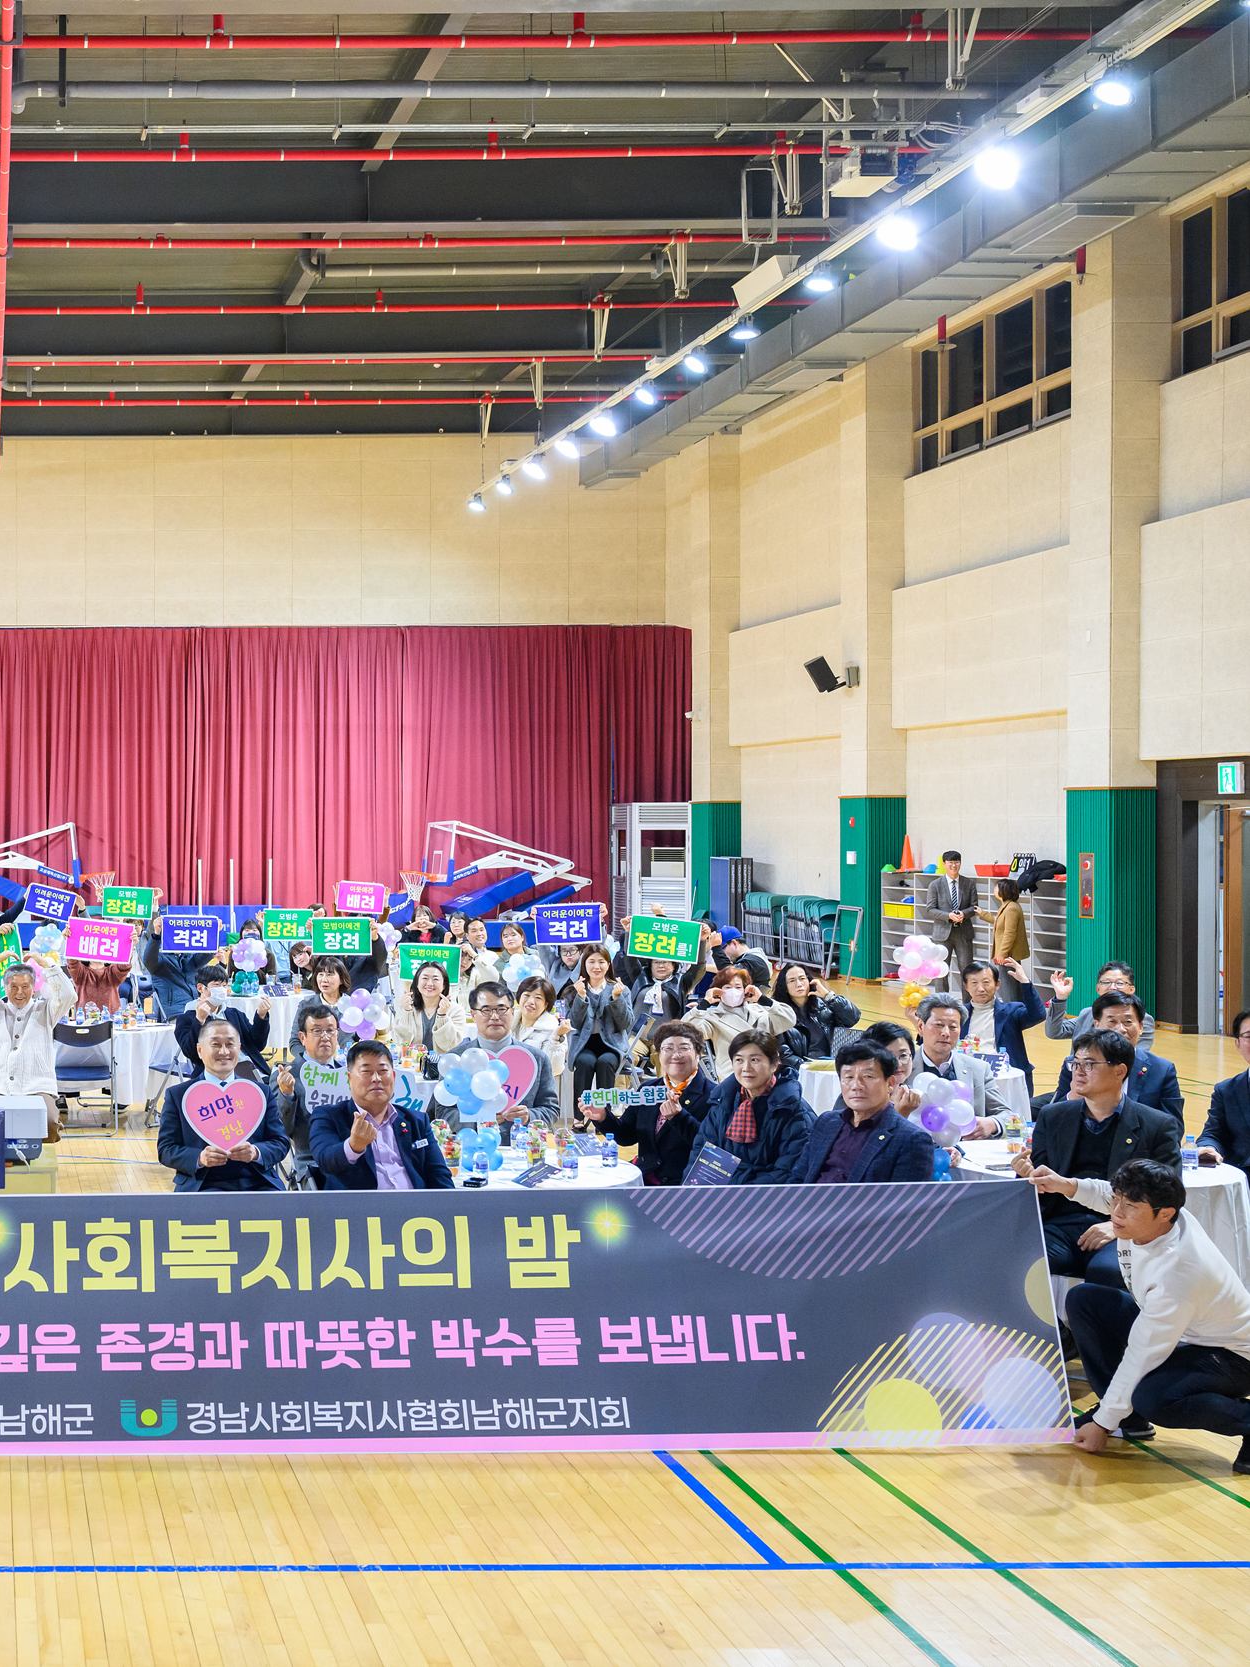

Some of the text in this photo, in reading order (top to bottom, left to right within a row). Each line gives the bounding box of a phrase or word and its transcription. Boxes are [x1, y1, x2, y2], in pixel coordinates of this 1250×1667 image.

[35, 897, 65, 917] 격려
[346, 894, 375, 910] 배려
[543, 909, 593, 919] 어려운이에겐
[174, 930, 208, 947] 격려
[549, 920, 588, 940] 격려
[652, 922, 679, 934] 모범은
[79, 936, 119, 958] 배려
[324, 933, 359, 950] 장려
[634, 932, 692, 957] 장려를!
[303, 1064, 339, 1087] 함께
[583, 1086, 667, 1106] #연대하는 협회
[215, 1119, 245, 1141] 경남
[3, 1215, 472, 1294] 사회복지사의
[504, 1214, 581, 1289] 밤
[96, 1321, 249, 1371] 존경과
[264, 1317, 417, 1370] 따뜻한
[431, 1317, 582, 1367] 박수를
[598, 1313, 806, 1365] 보냅니다.
[0, 1403, 95, 1436] 남해군
[186, 1397, 631, 1434] 경남사회복지사협회남해군지회
